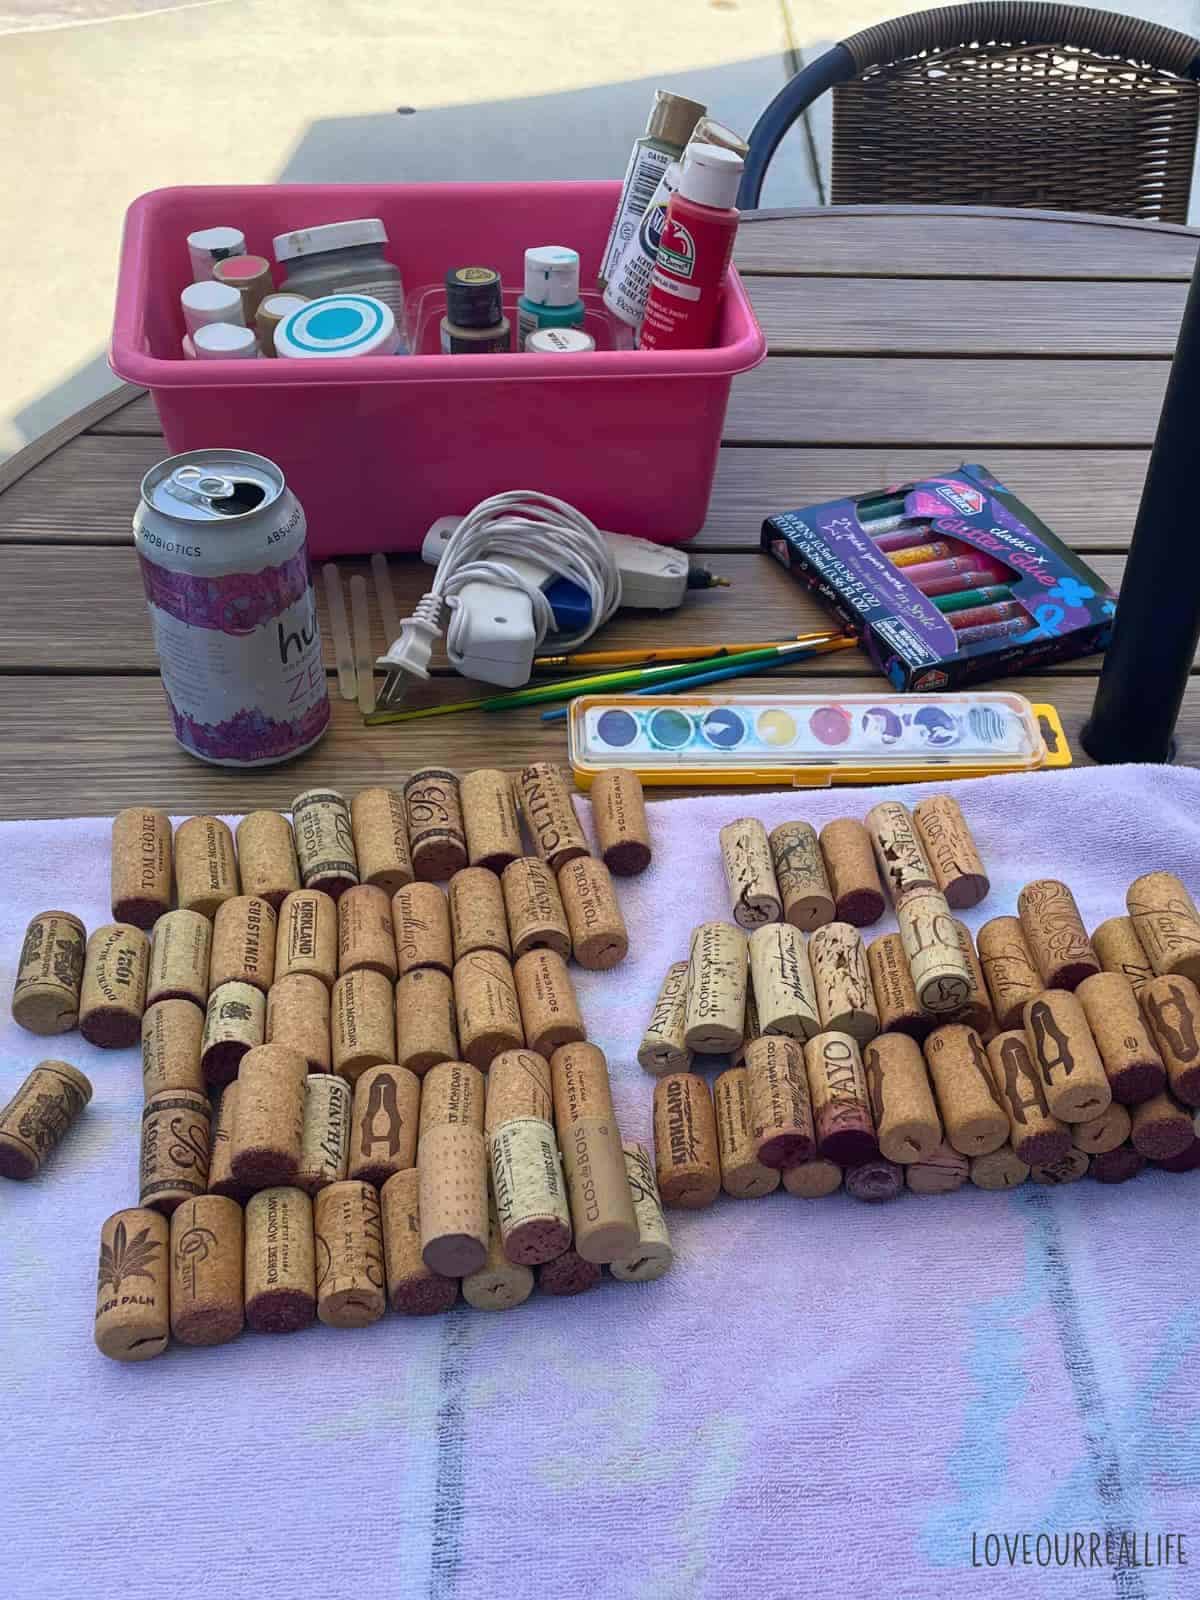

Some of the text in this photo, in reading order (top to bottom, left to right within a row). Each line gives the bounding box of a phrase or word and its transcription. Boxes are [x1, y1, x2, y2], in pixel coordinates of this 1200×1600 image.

[140, 529, 201, 557] PROBIOTICS
[773, 515, 799, 542] TOTAL
[283, 660, 321, 706] ZE
[521, 767, 561, 852] CLINE
[613, 775, 627, 832] SOUVERAIN
[142, 815, 155, 888] TOM GORE
[243, 901, 262, 973] SUBSTANCE
[299, 901, 313, 955] KIRKLAND
[583, 902, 598, 929] TOM
[540, 956, 559, 1013] SOUVERAIN
[563, 1055, 579, 1122] SOUVERAIN
[823, 1041, 863, 1127] MAYO
[327, 1086, 343, 1142] HANDS
[667, 1081, 687, 1166] KIRKLAND
[574, 1128, 589, 1164] BOIS
[583, 1180, 601, 1223] CLOS
[267, 1196, 280, 1285] ROBERT MONDAVI
[121, 1295, 155, 1308] PALM
